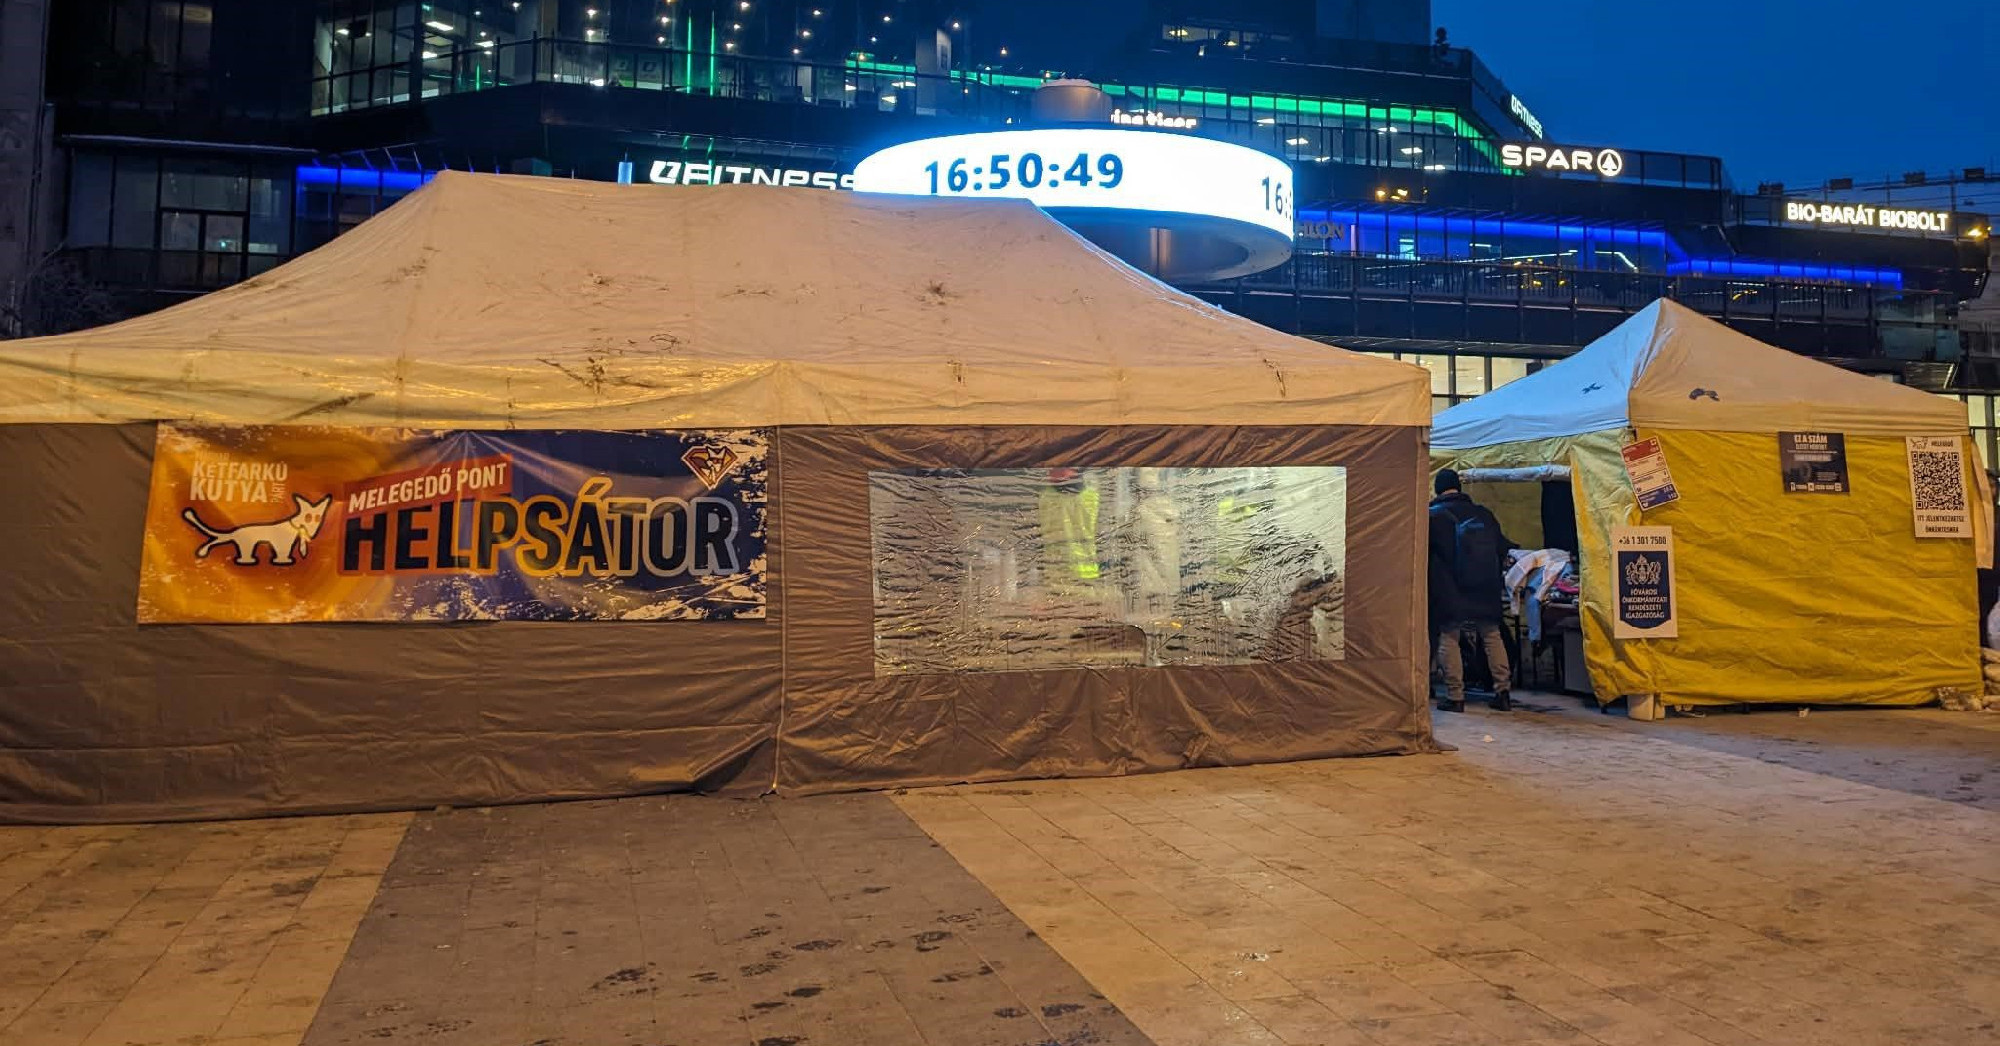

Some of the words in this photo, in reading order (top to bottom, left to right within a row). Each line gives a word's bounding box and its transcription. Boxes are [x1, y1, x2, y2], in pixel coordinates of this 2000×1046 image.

[924, 152, 1124, 195] 16:50:49
[1502, 144, 1594, 170] SPAR
[1787, 202, 1875, 226] BIO-BARÁT
[1879, 209, 1948, 231] BIOBOLT
[190, 477, 268, 503] KUTYA
[347, 467, 453, 513] MELEGEDŐ
[456, 462, 508, 491] PONT
[338, 477, 741, 577] HELPSÁTOR
